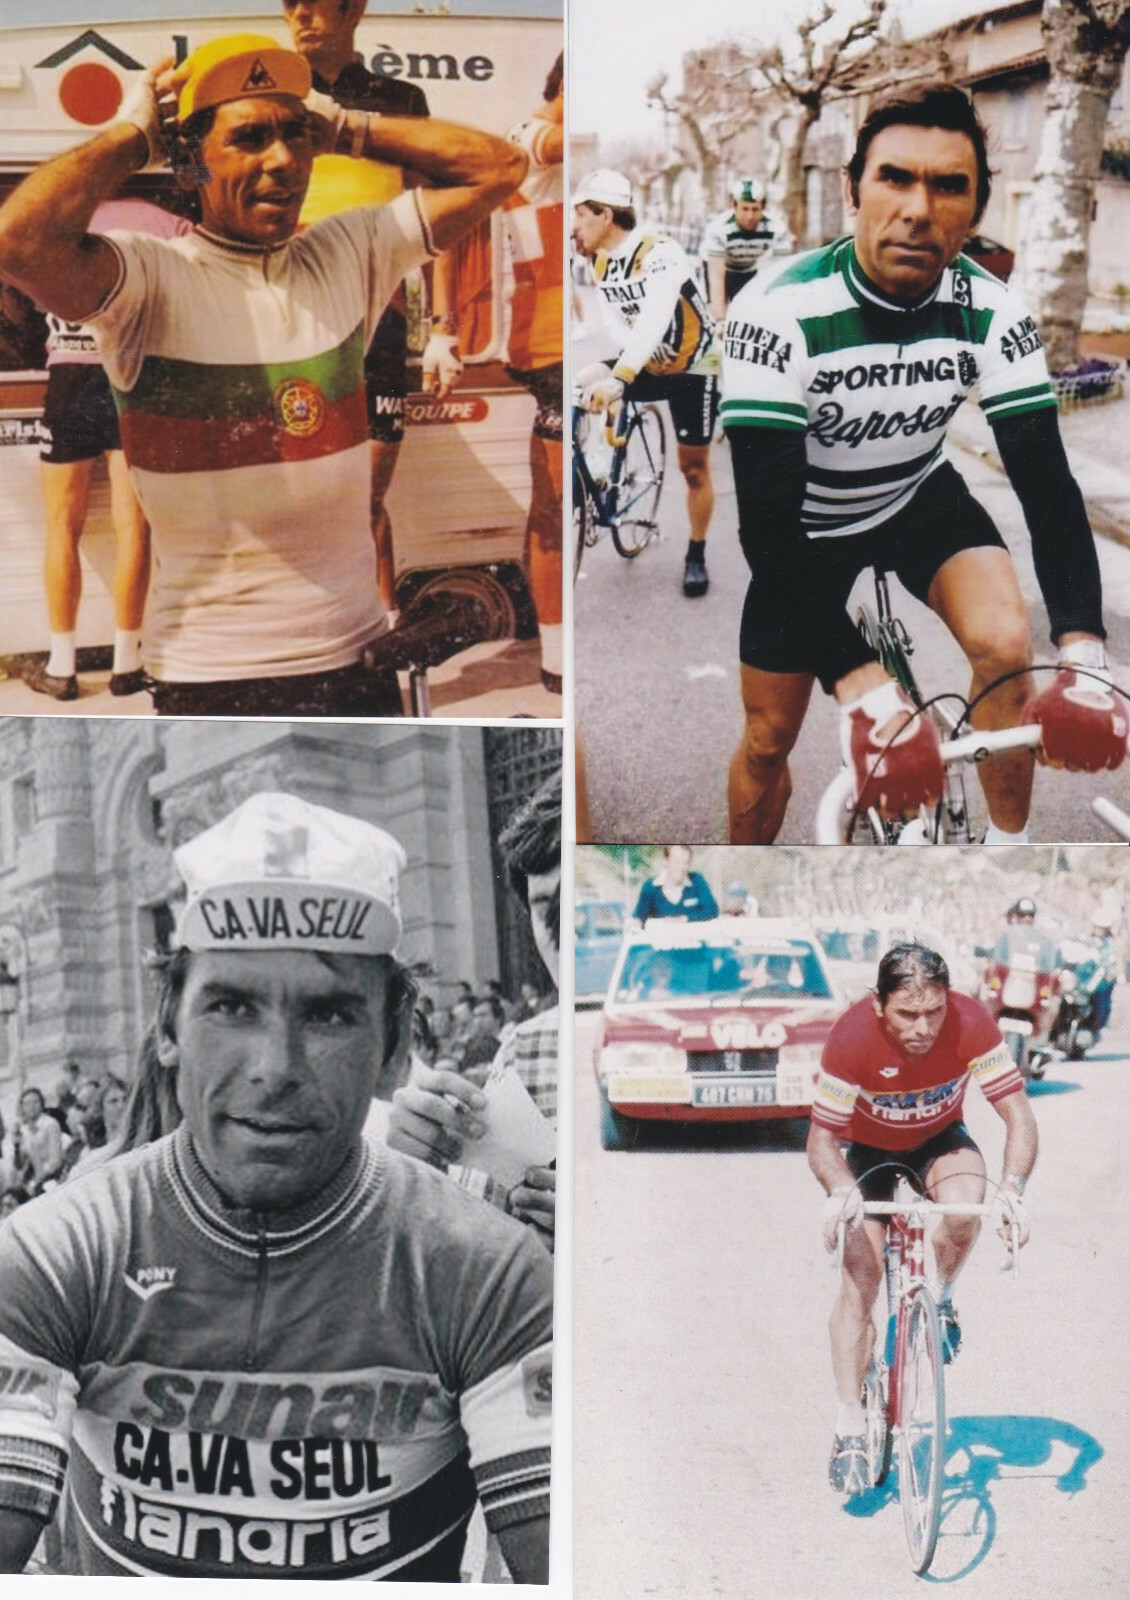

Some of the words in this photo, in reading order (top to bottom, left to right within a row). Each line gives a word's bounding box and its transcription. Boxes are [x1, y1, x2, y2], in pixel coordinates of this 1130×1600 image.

[370, 43, 495, 81] ème
[808, 357, 955, 394] SPORTING
[297, 898, 372, 940] SEUL
[137, 1266, 176, 1282] PONY
[270, 1437, 392, 1500] SEUL
